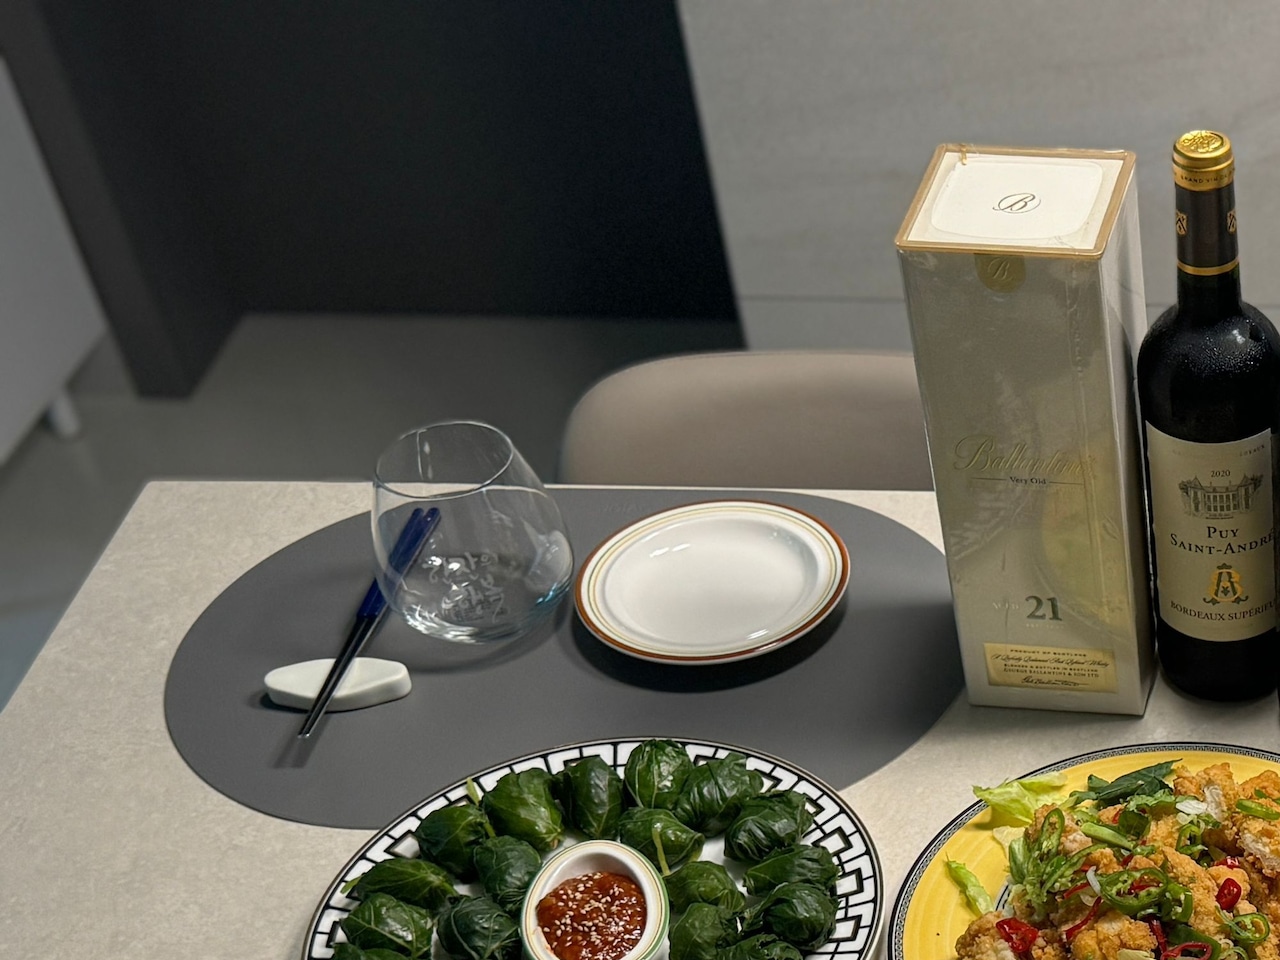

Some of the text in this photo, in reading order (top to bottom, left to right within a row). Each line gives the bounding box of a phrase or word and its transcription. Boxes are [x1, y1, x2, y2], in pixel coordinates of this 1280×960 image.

[1009, 476, 1047, 486] Very Old
[1210, 470, 1231, 478] 2020
[1025, 595, 1063, 622] 21
[1170, 600, 1276, 621] BORDEAUX SUPÉRIEU
